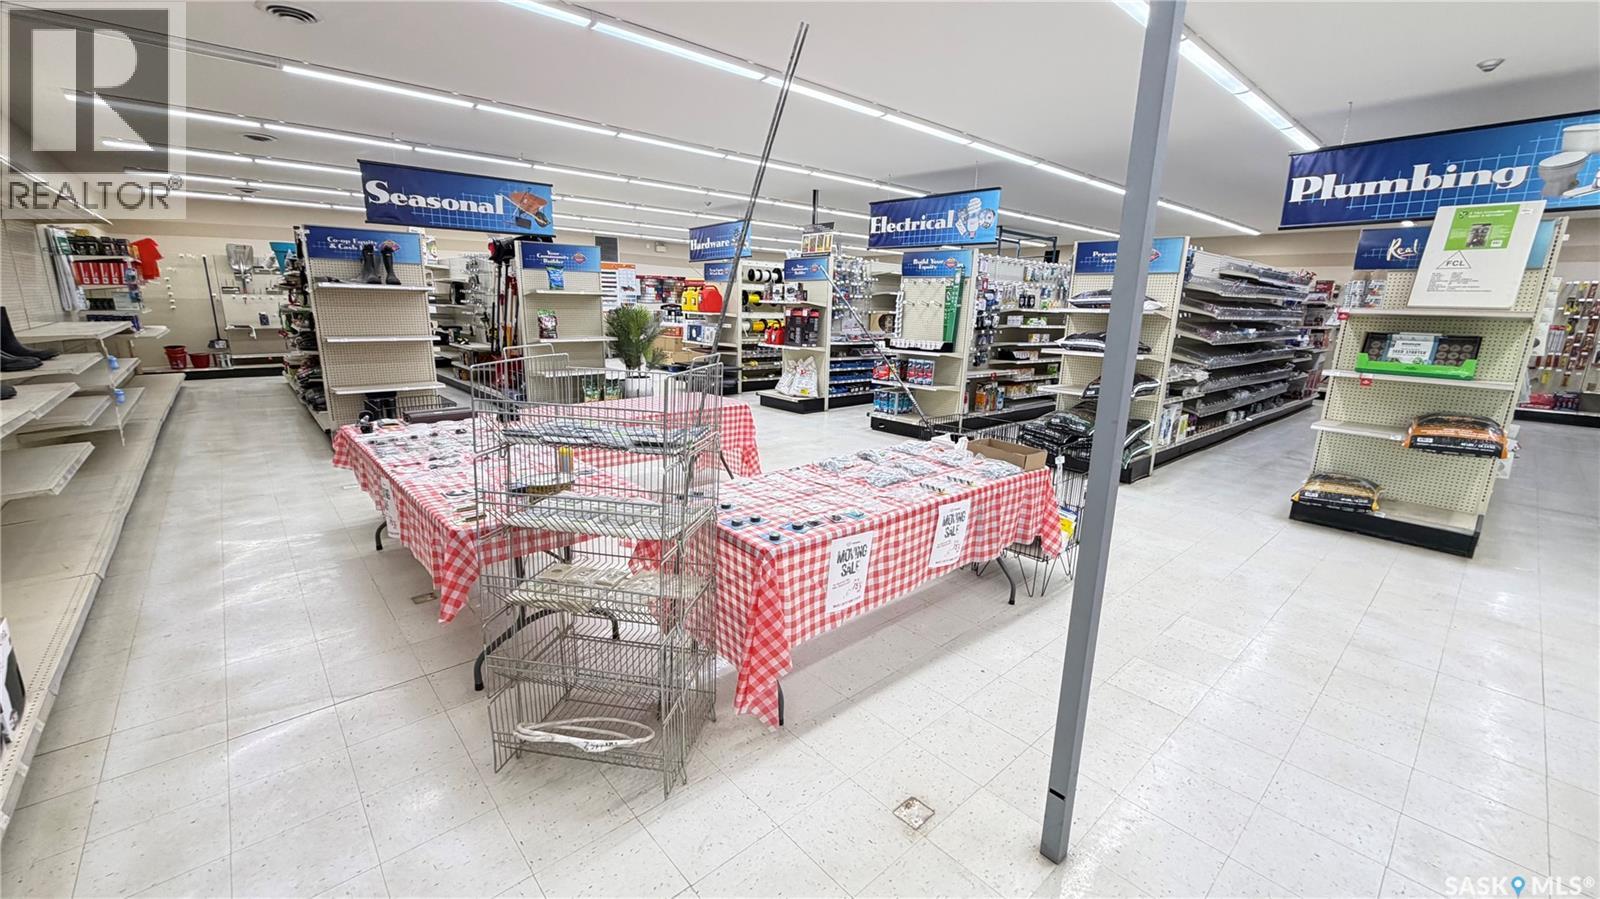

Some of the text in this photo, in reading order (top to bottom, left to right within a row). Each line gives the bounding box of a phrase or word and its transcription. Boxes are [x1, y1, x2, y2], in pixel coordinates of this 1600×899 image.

[1288, 163, 1530, 203] Plumbing
[365, 180, 504, 215] Seasonal
[870, 210, 954, 234] Electrical
[690, 237, 729, 251] Hardware
[1387, 238, 1419, 262] Real
[942, 510, 967, 527] MOVING
[836, 543, 868, 564] MOVING
